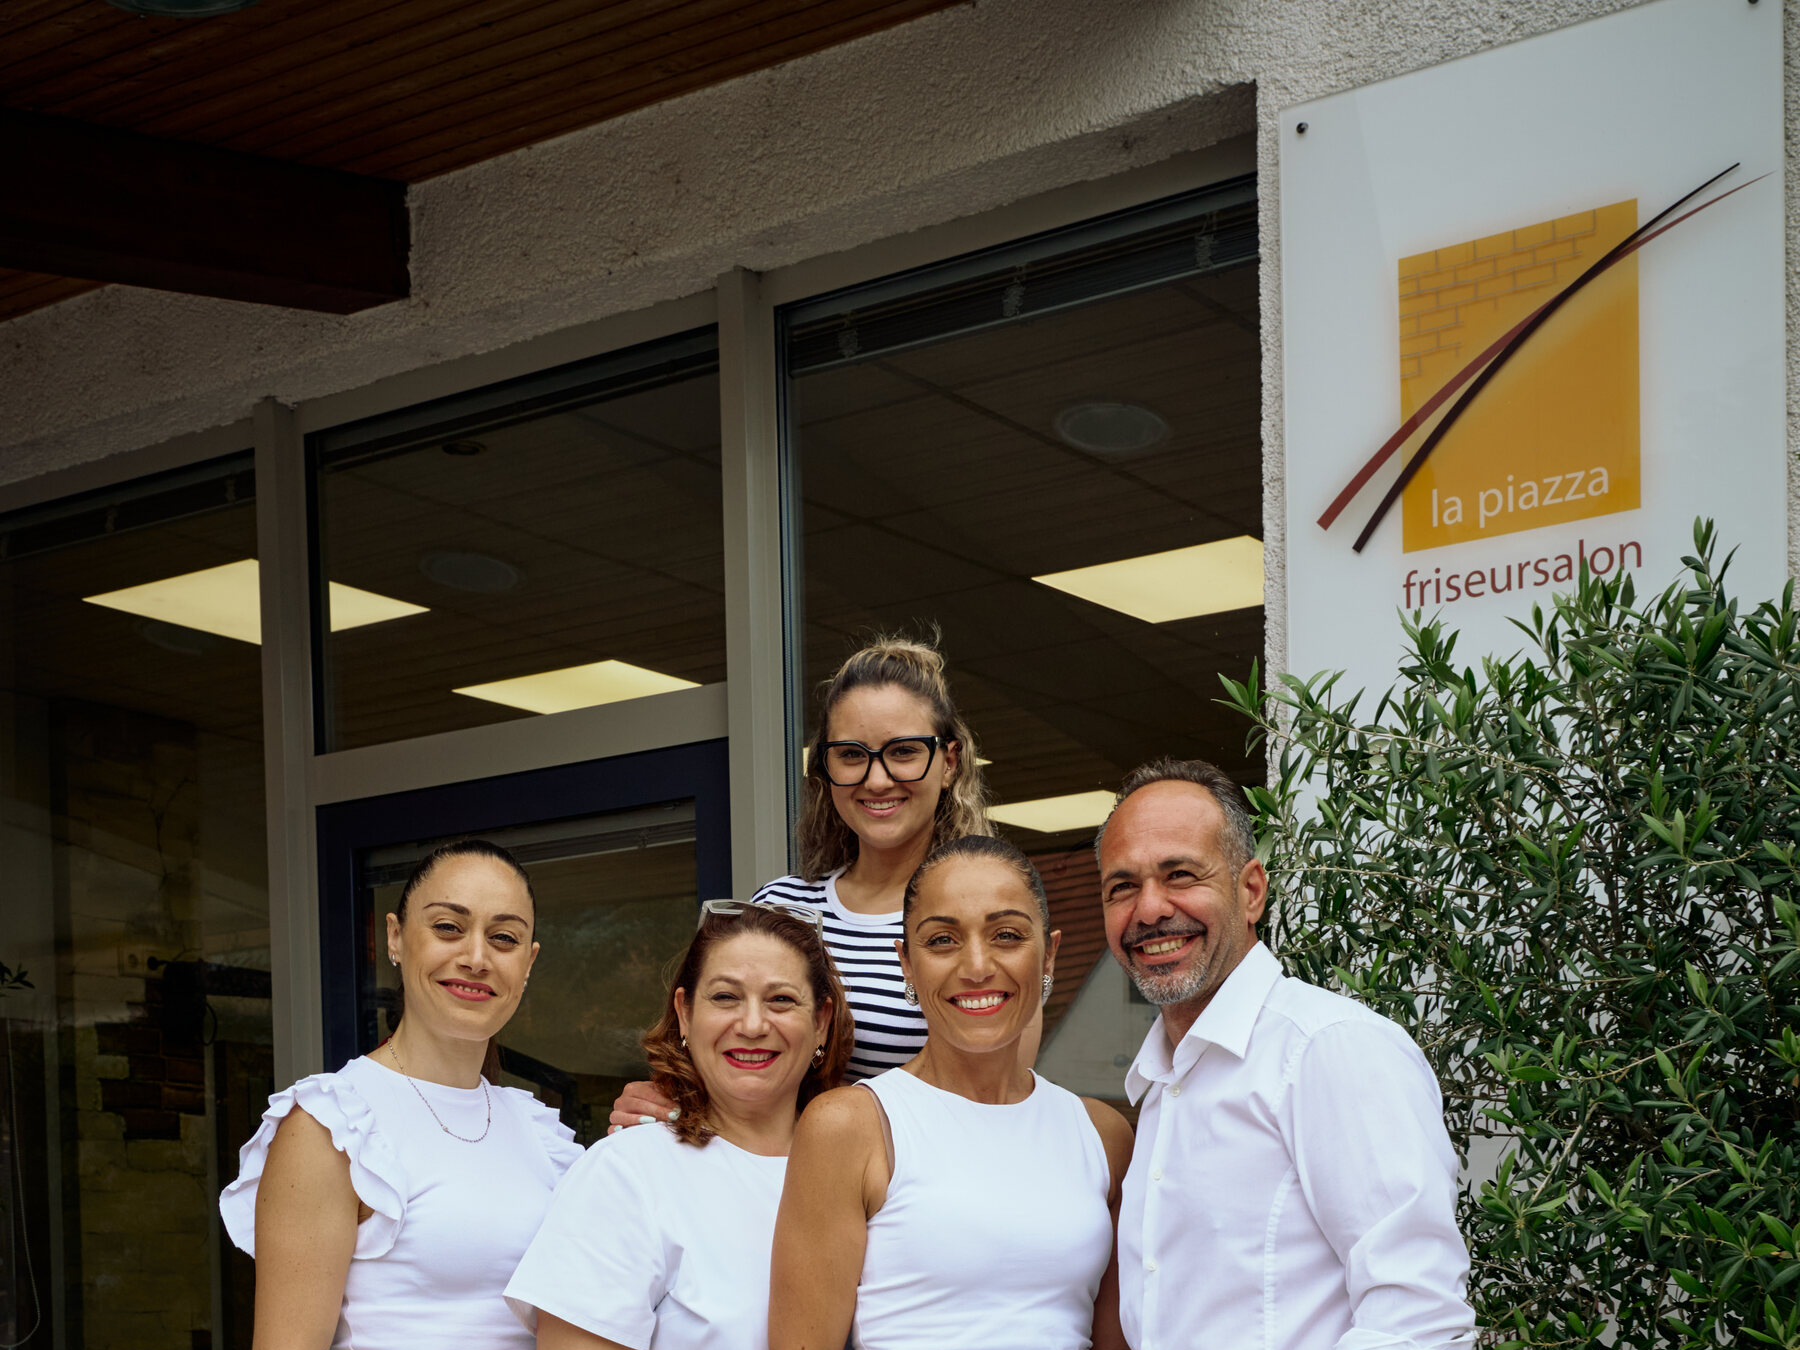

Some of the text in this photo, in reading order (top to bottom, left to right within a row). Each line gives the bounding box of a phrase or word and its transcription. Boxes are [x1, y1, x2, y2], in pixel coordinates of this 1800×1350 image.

[1432, 466, 1609, 529] la piazza
[1402, 539, 1643, 609] friseursalon
